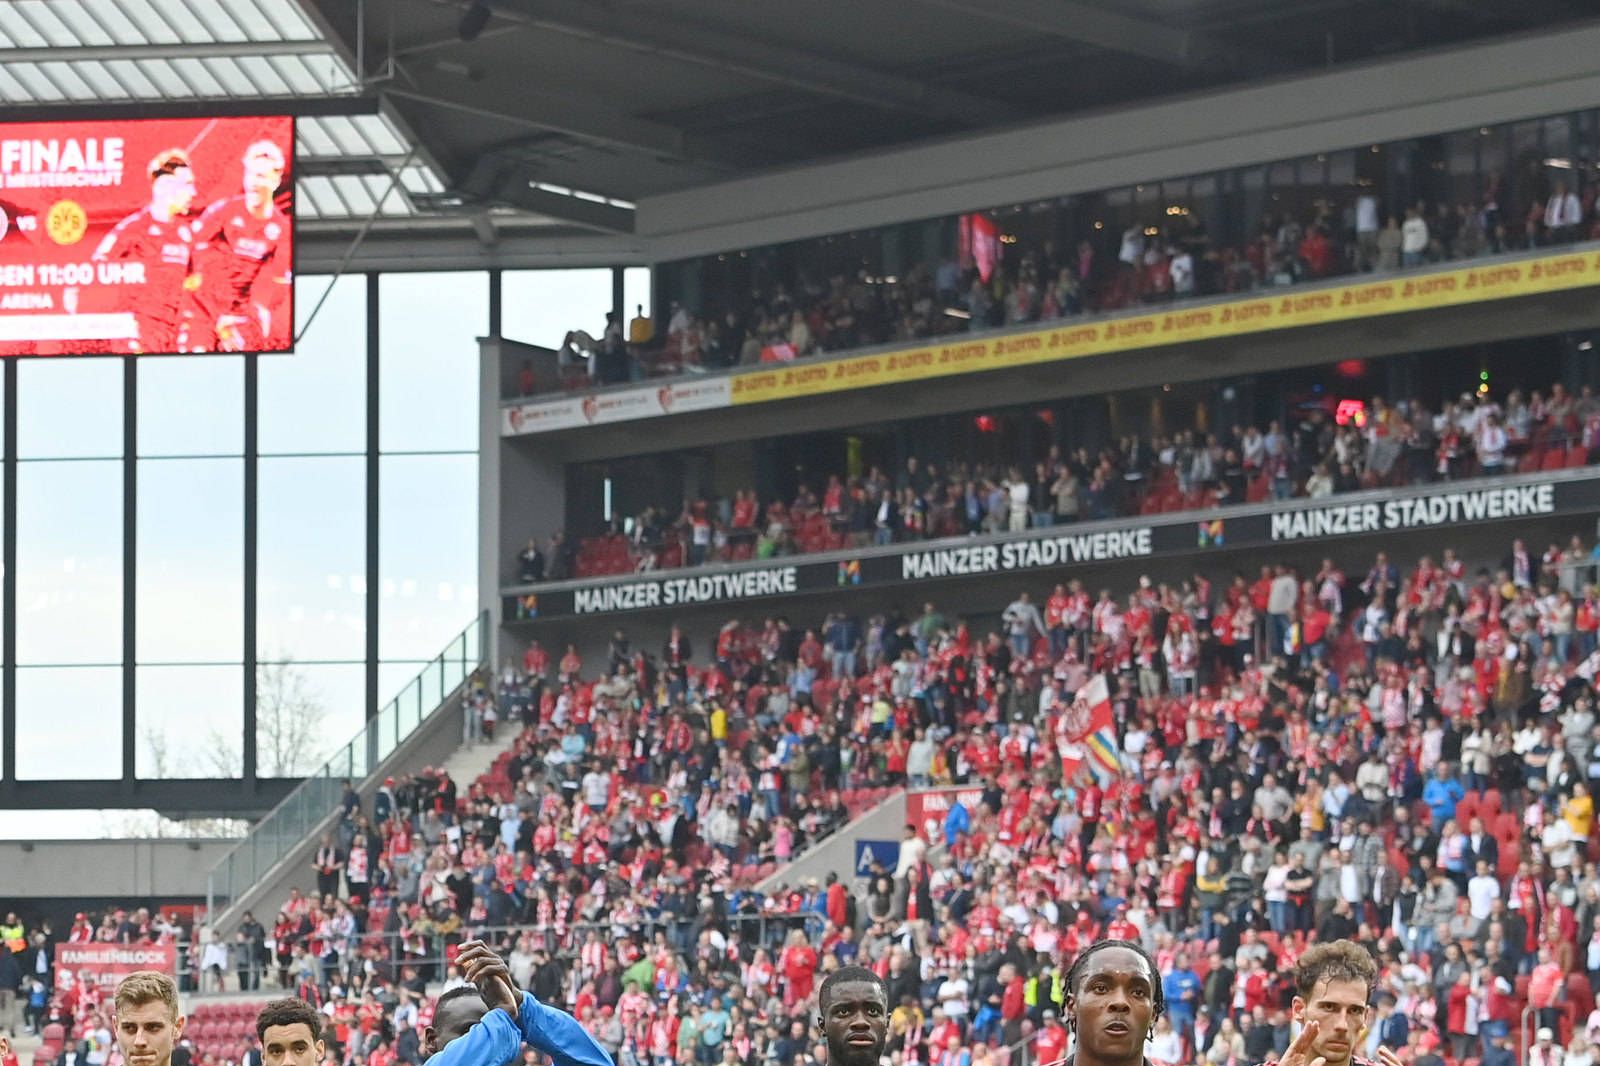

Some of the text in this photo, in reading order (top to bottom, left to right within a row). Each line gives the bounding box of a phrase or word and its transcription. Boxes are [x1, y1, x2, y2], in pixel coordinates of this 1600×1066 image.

[1, 138, 124, 172] FINALE
[16, 215, 37, 231] VS
[37, 262, 94, 286] 11:00
[97, 262, 146, 284] UHR
[573, 581, 660, 613] MAINZER
[663, 568, 798, 608] STADTWERKE
[902, 546, 998, 579] MAINZER
[1001, 528, 1153, 569] STADTWERKE
[1271, 505, 1380, 541] MAINZER
[1384, 485, 1554, 528] STADTWERKE
[61, 950, 166, 965] FAMILIENBLOCK
